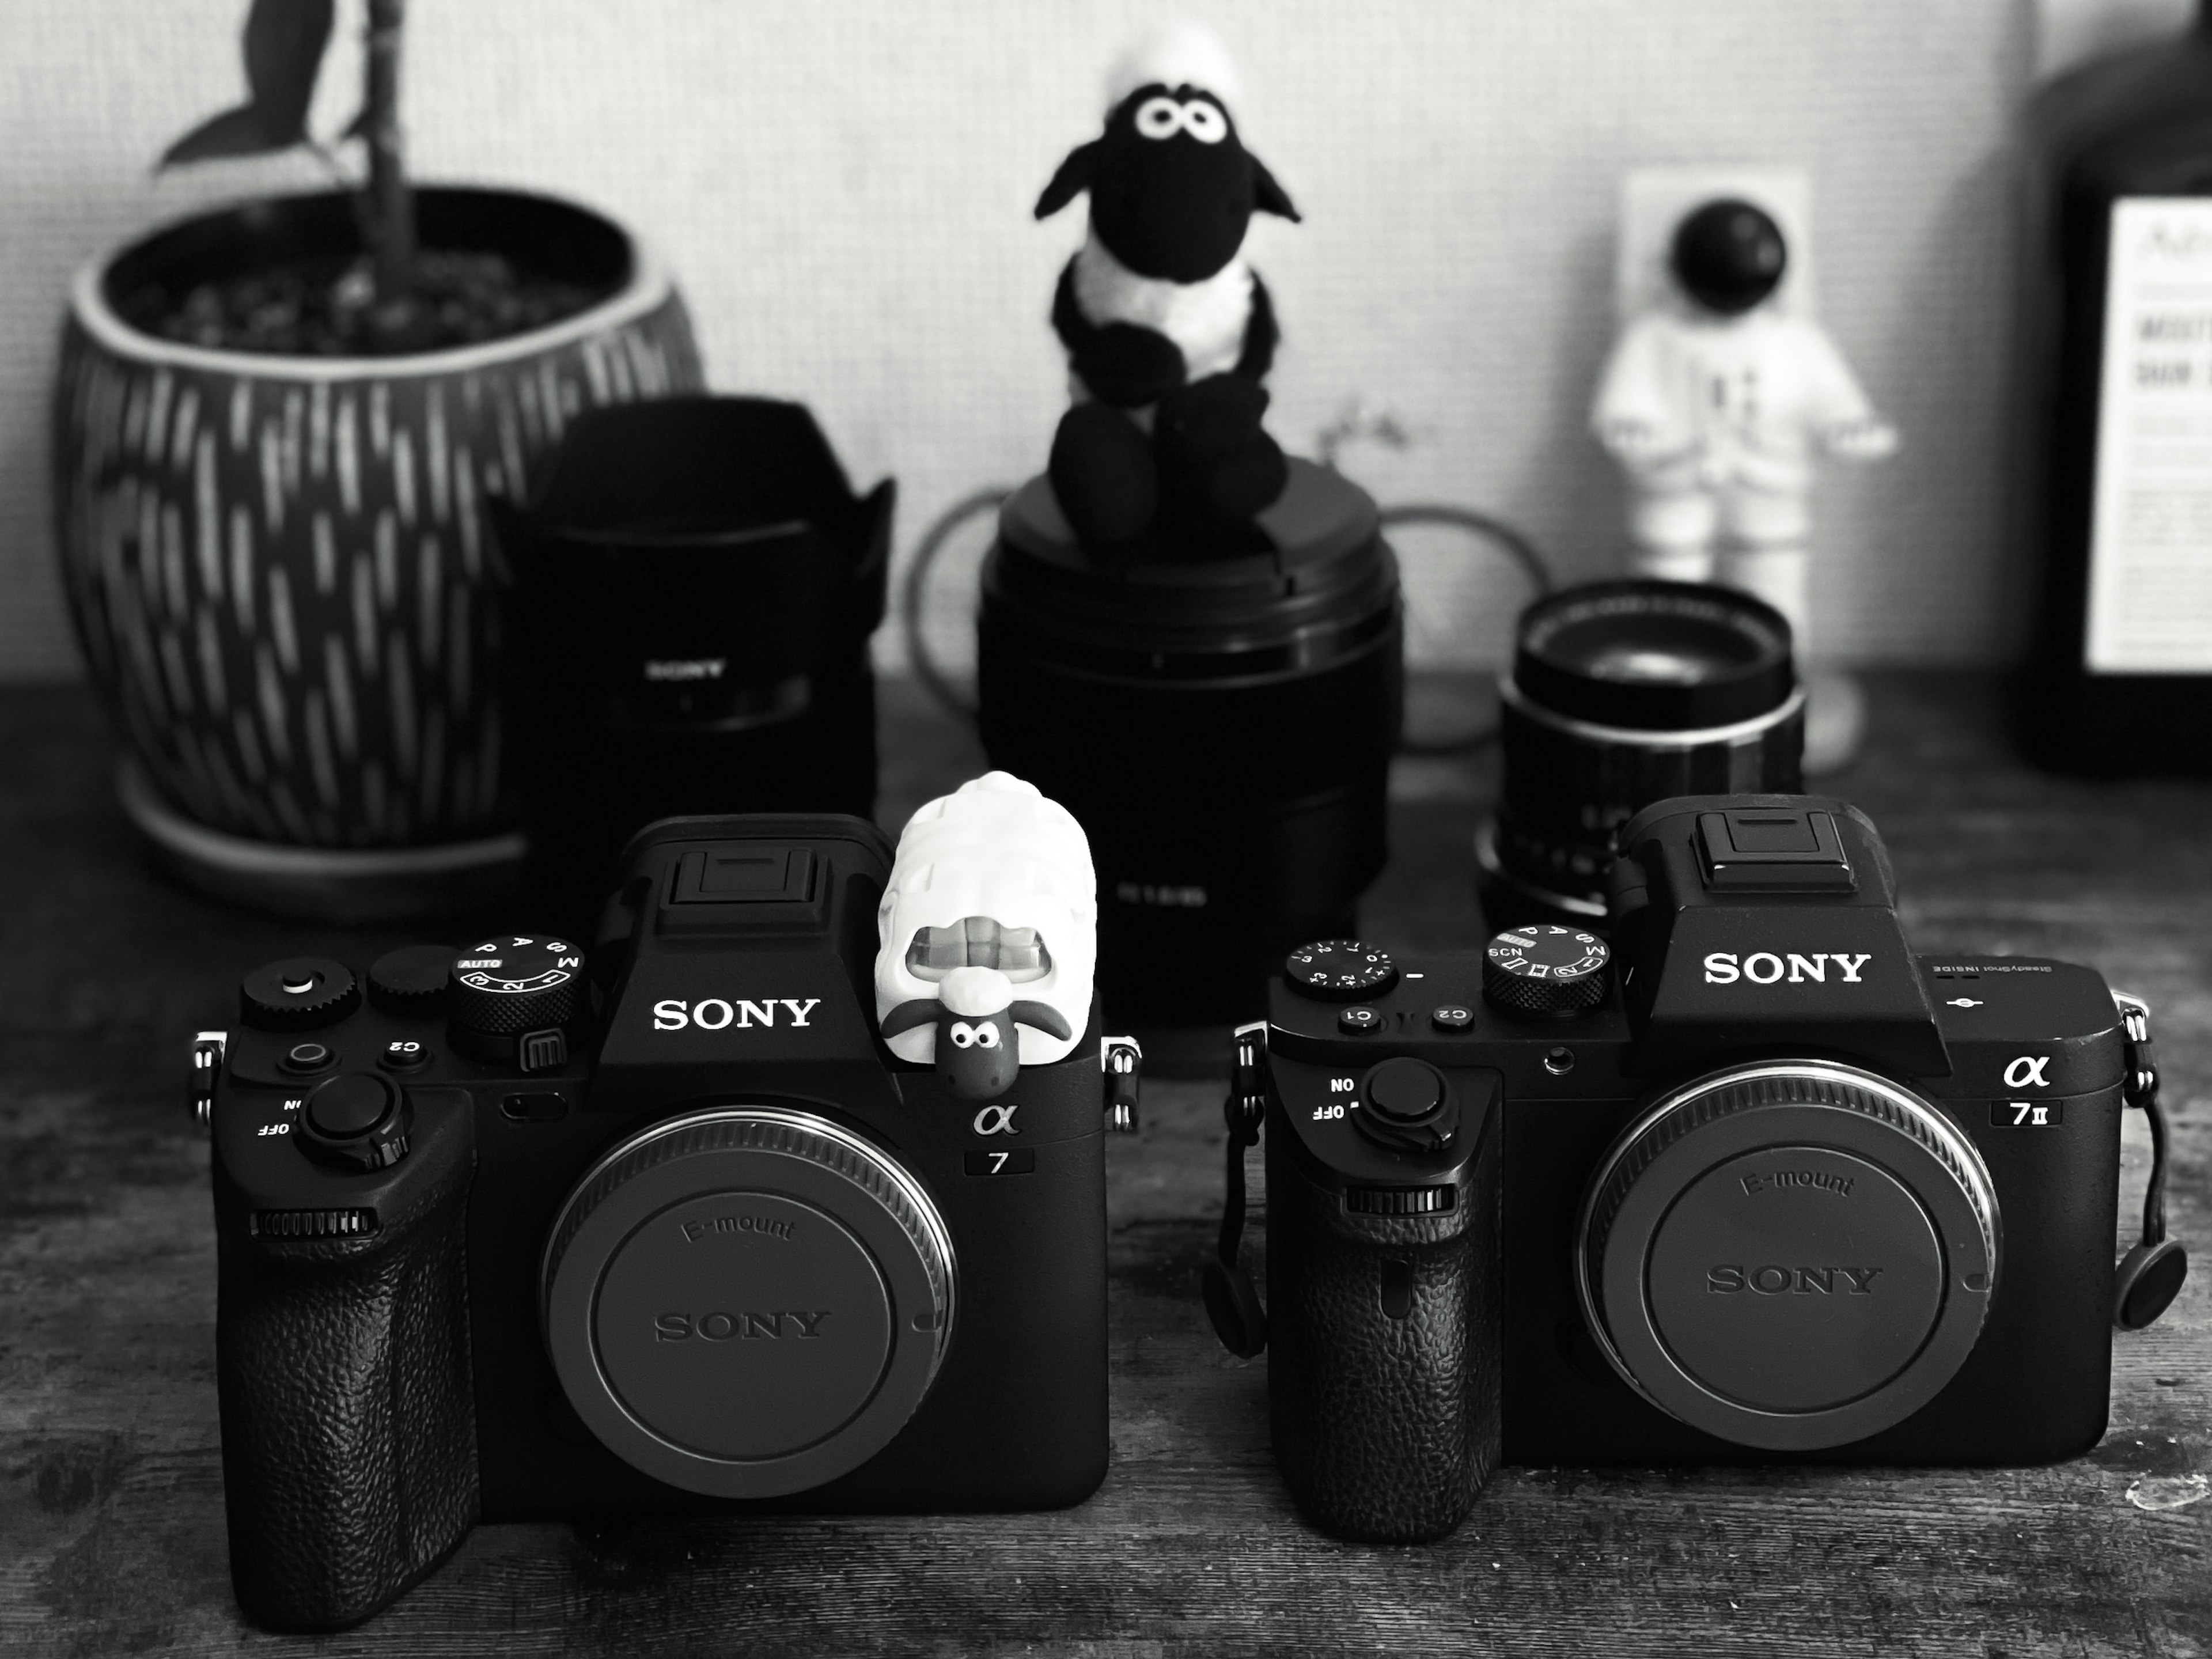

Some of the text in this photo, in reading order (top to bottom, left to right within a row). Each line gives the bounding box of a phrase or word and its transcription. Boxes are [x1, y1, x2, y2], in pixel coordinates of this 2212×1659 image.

[1518, 926, 1538, 934] P
[1548, 926, 1568, 934] A
[512, 937, 533, 946] A
[1575, 933, 1594, 943] S
[475, 944, 497, 952] P
[546, 942, 567, 952] S
[1488, 948, 1522, 957] SCN
[1586, 945, 1606, 956] M
[459, 960, 502, 968] AUTO
[557, 957, 579, 968] M
[1582, 958, 1594, 967] 1
[1703, 952, 1872, 984] SONY
[1558, 966, 1578, 975] 2
[470, 975, 490, 986] 3
[541, 974, 559, 983] 1
[502, 982, 525, 990] 2
[653, 998, 821, 1031] SONY
[1347, 1010, 1372, 1020] C1
[1438, 1010, 1467, 1019] C2
[389, 1041, 420, 1052] C2
[1331, 1078, 1354, 1093] ON
[283, 1100, 302, 1111] N
[1312, 1105, 1344, 1120] OFF
[257, 1123, 289, 1136] OFF
[988, 1152, 1009, 1174] 7
[1740, 1171, 1854, 1197] E-mount
[681, 1217, 795, 1242] E-mount
[1707, 1265, 1884, 1296] SONY
[655, 1312, 831, 1342] SONY
